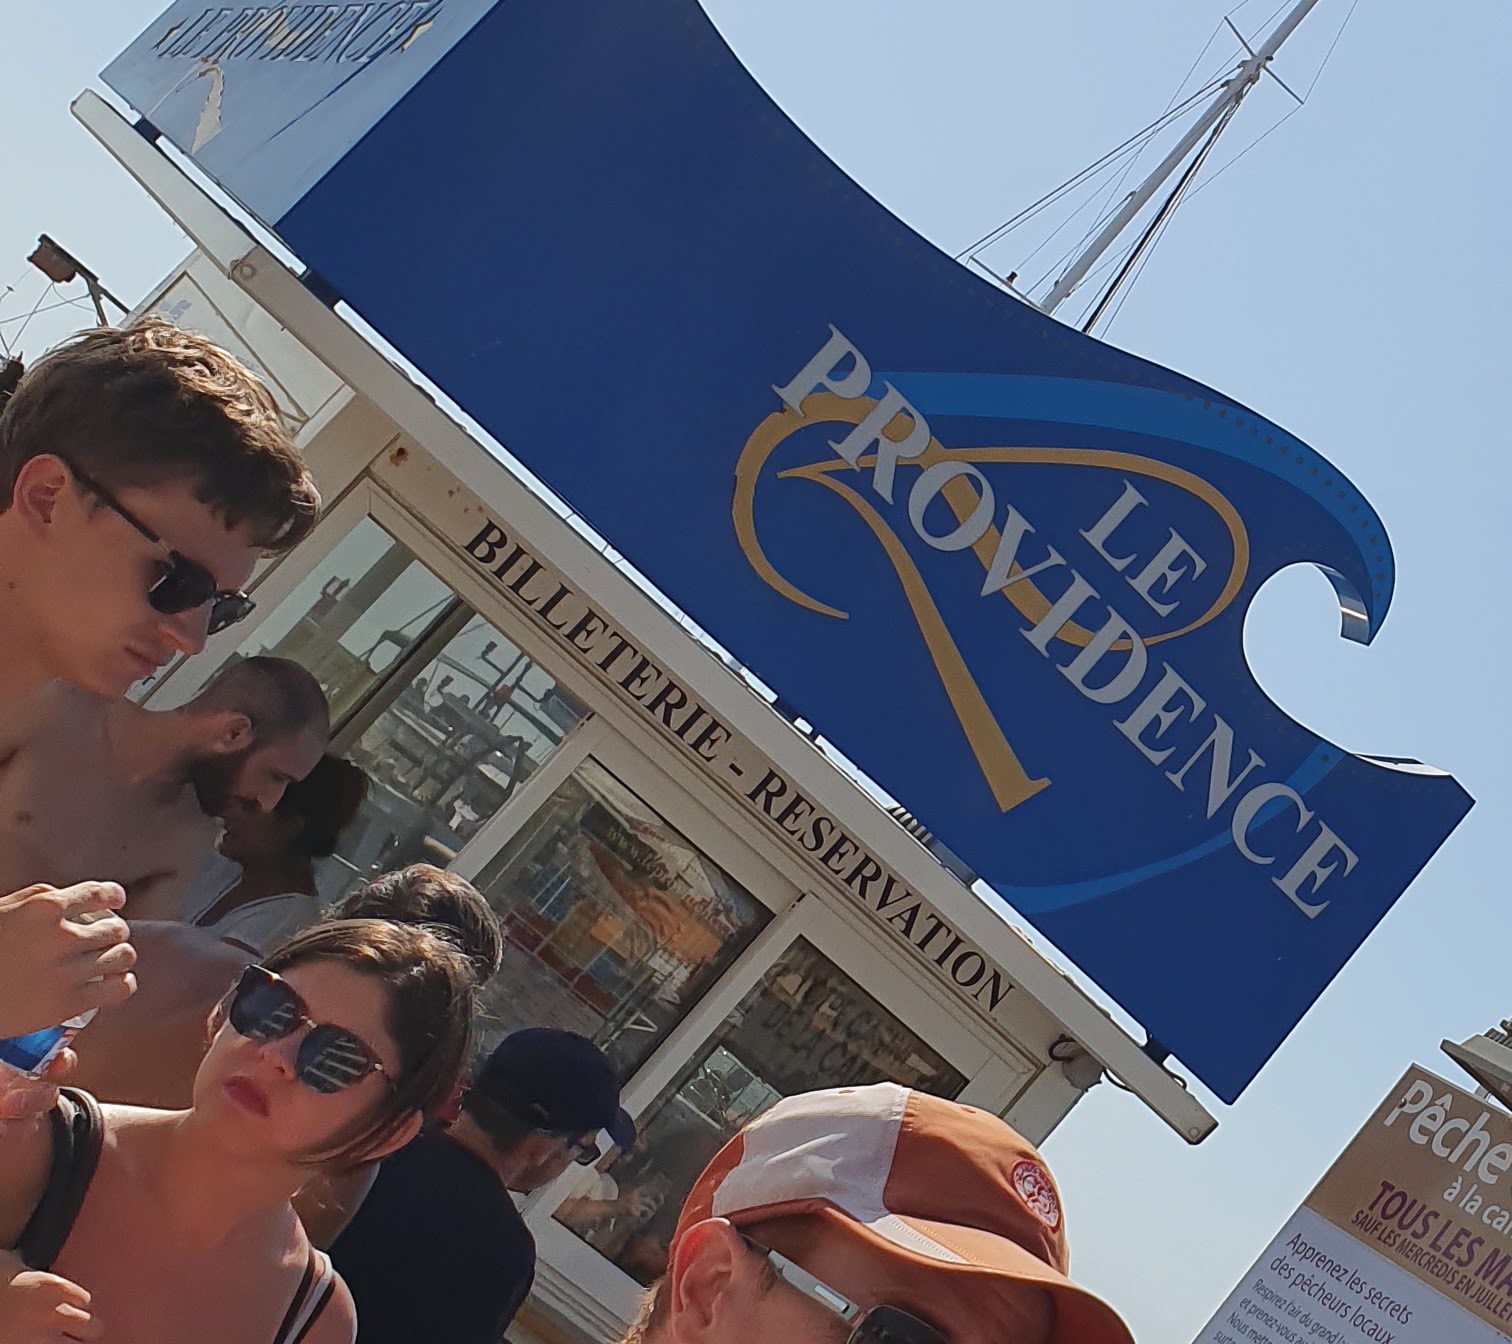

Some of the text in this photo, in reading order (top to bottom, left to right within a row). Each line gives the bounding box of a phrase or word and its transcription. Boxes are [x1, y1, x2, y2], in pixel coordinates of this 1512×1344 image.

[1079, 478, 1208, 618] LE
[771, 322, 1360, 921] PROVIDENCE
[463, 517, 733, 763] BILLETERIE
[745, 769, 1016, 1012] RESERVATION
[1366, 1180, 1440, 1240] TOUS
[1427, 1218, 1485, 1268] LES
[1441, 1175, 1464, 1202] à
[1458, 1183, 1485, 1215] la
[1268, 1253, 1297, 1280] des
[1288, 1270, 1353, 1320] pêcheurs
[1284, 1231, 1413, 1325] Apprenez les secrets
[1349, 1209, 1383, 1236] SAUF
[1376, 1225, 1401, 1248] LES
[1394, 1237, 1459, 1285] MERCREDIS
[1453, 1273, 1476, 1296] EN
[1225, 1311, 1250, 1334] Nous
[1238, 1296, 1252, 1310] et
[1245, 1303, 1297, 1343] prenez-vous
[1251, 1278, 1288, 1310] Respirez
[1297, 1310, 1314, 1328] du
[1307, 1320, 1340, 1344] grand
